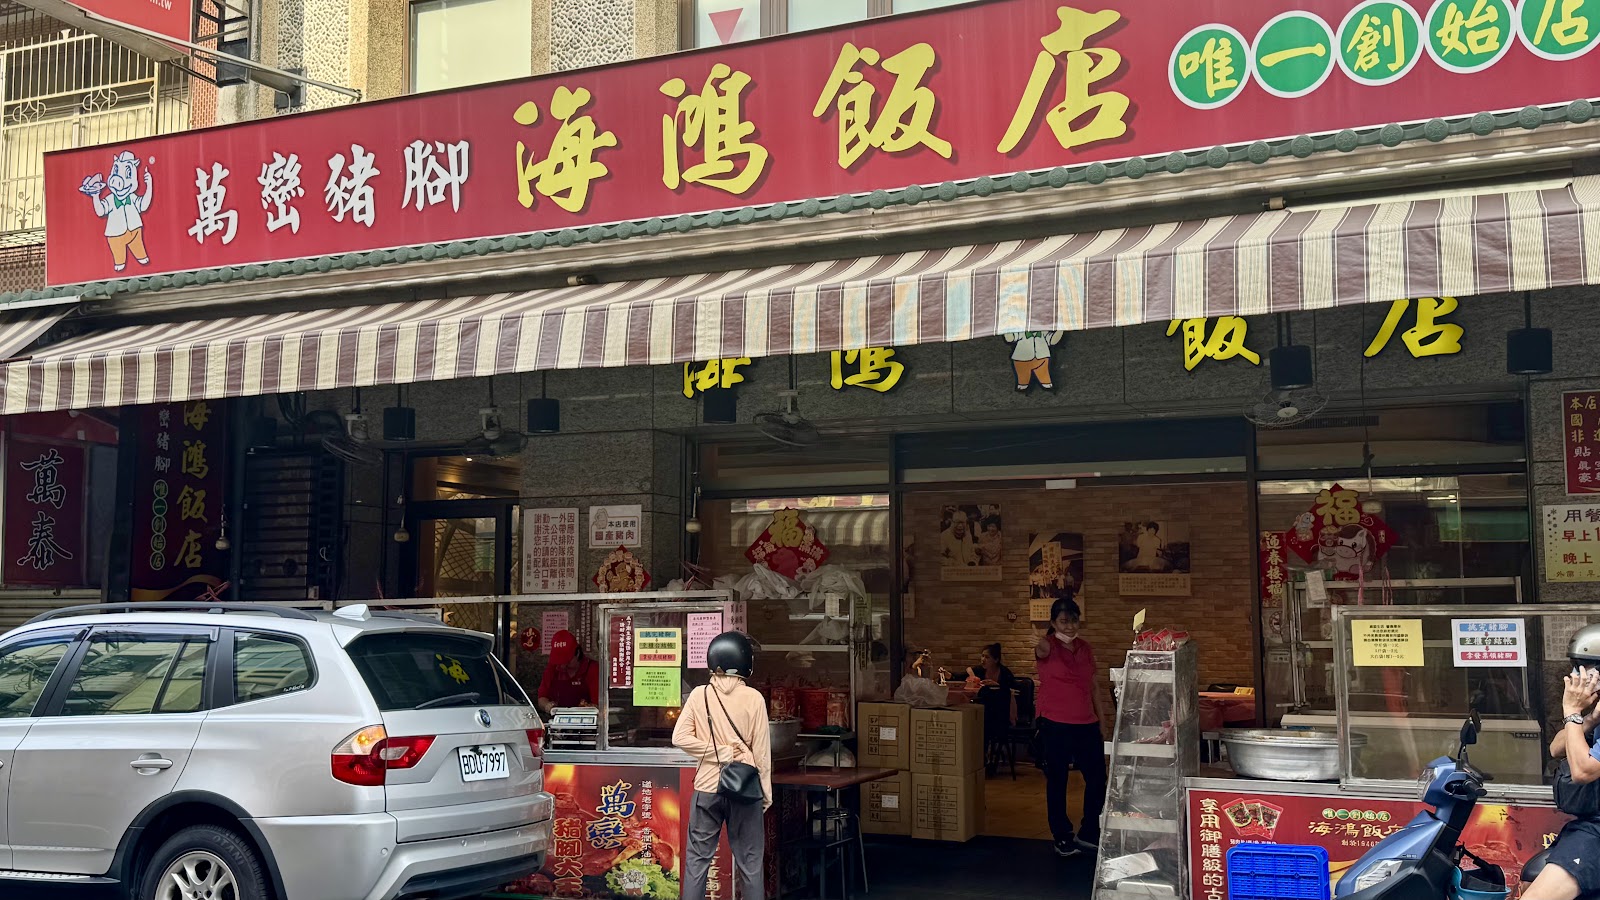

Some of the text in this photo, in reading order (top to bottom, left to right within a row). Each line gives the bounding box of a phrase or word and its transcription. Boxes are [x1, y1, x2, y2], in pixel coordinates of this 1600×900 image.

[188, 0, 1597, 245] 萬巒豬腳 海鴻飯店 唯一創始店
[1315, 489, 1361, 526] 福
[768, 508, 804, 547] 福
[1563, 552, 1594, 565] 晚上
